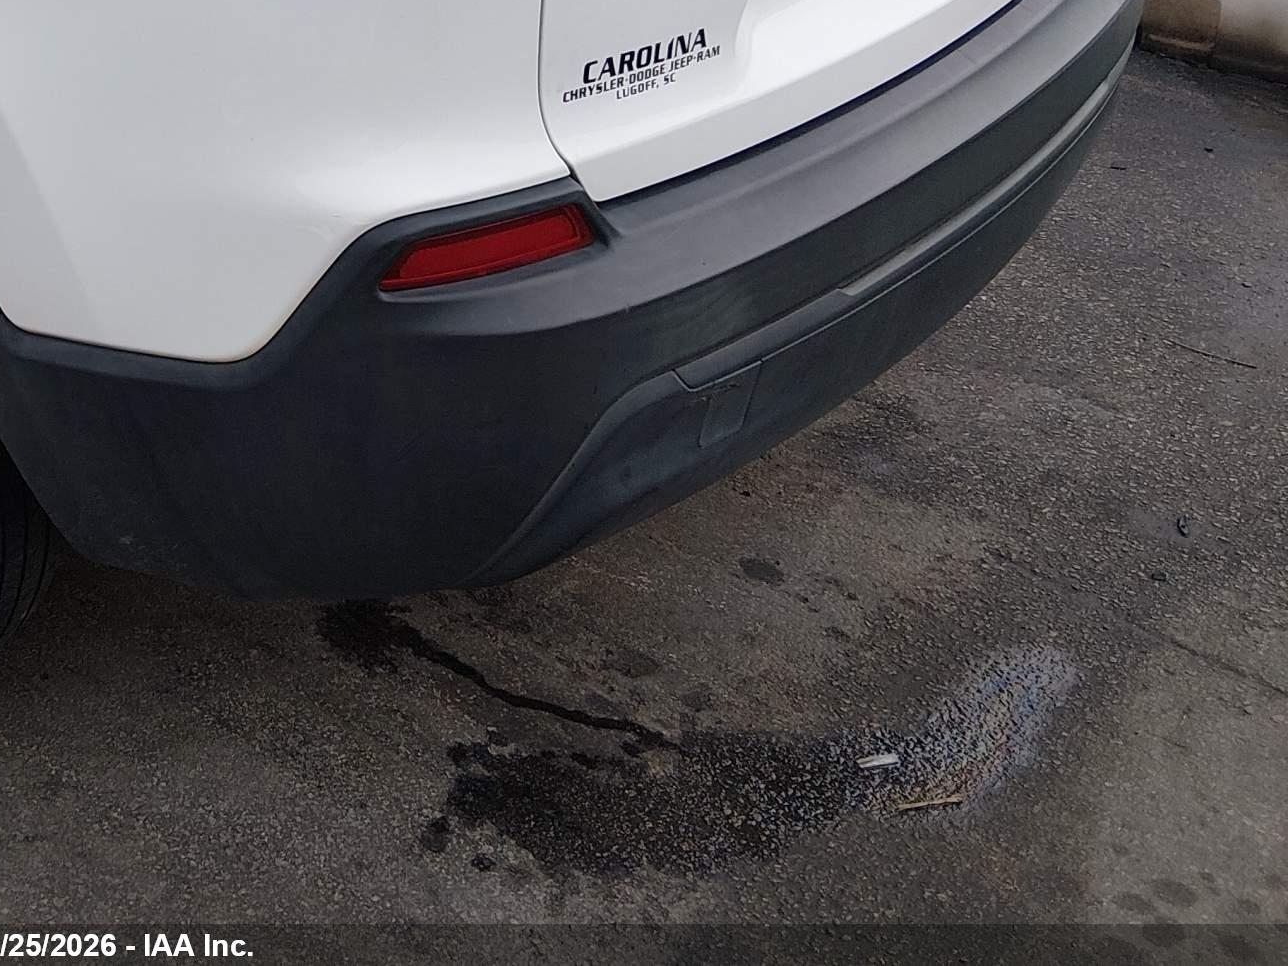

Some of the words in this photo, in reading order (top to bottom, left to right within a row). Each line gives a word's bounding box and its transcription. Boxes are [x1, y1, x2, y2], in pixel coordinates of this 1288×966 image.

[583, 28, 707, 84] CAROLINA
[616, 78, 659, 100] LUGOFF,
[663, 73, 677, 86] SC
